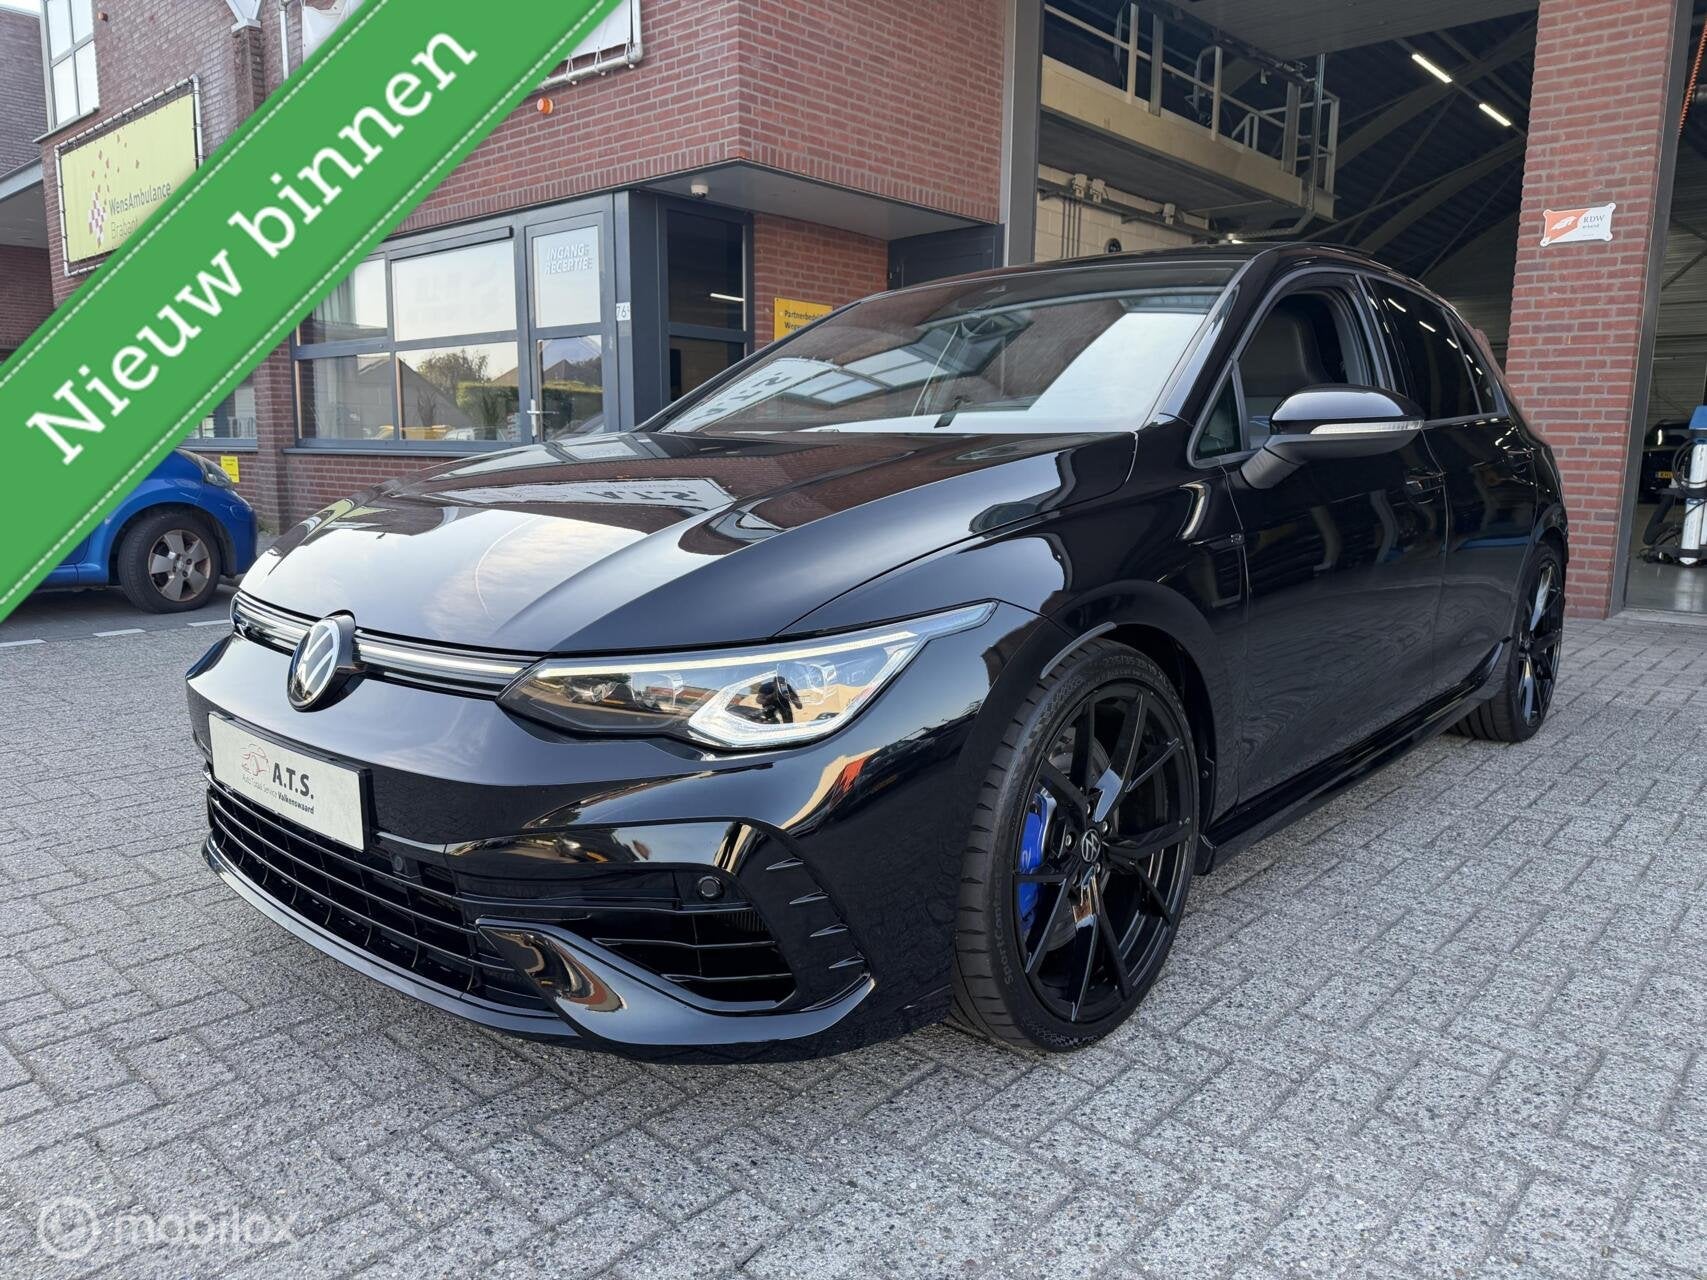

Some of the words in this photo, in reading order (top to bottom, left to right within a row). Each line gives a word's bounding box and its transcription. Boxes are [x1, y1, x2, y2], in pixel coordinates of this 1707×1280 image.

[108, 181, 172, 216] WensAmbulance
[547, 243, 586, 260] INGANG
[545, 256, 592, 276] RECEPTIE
[272, 763, 315, 799] A.T.S.
[277, 791, 315, 815] Valkenswaard
